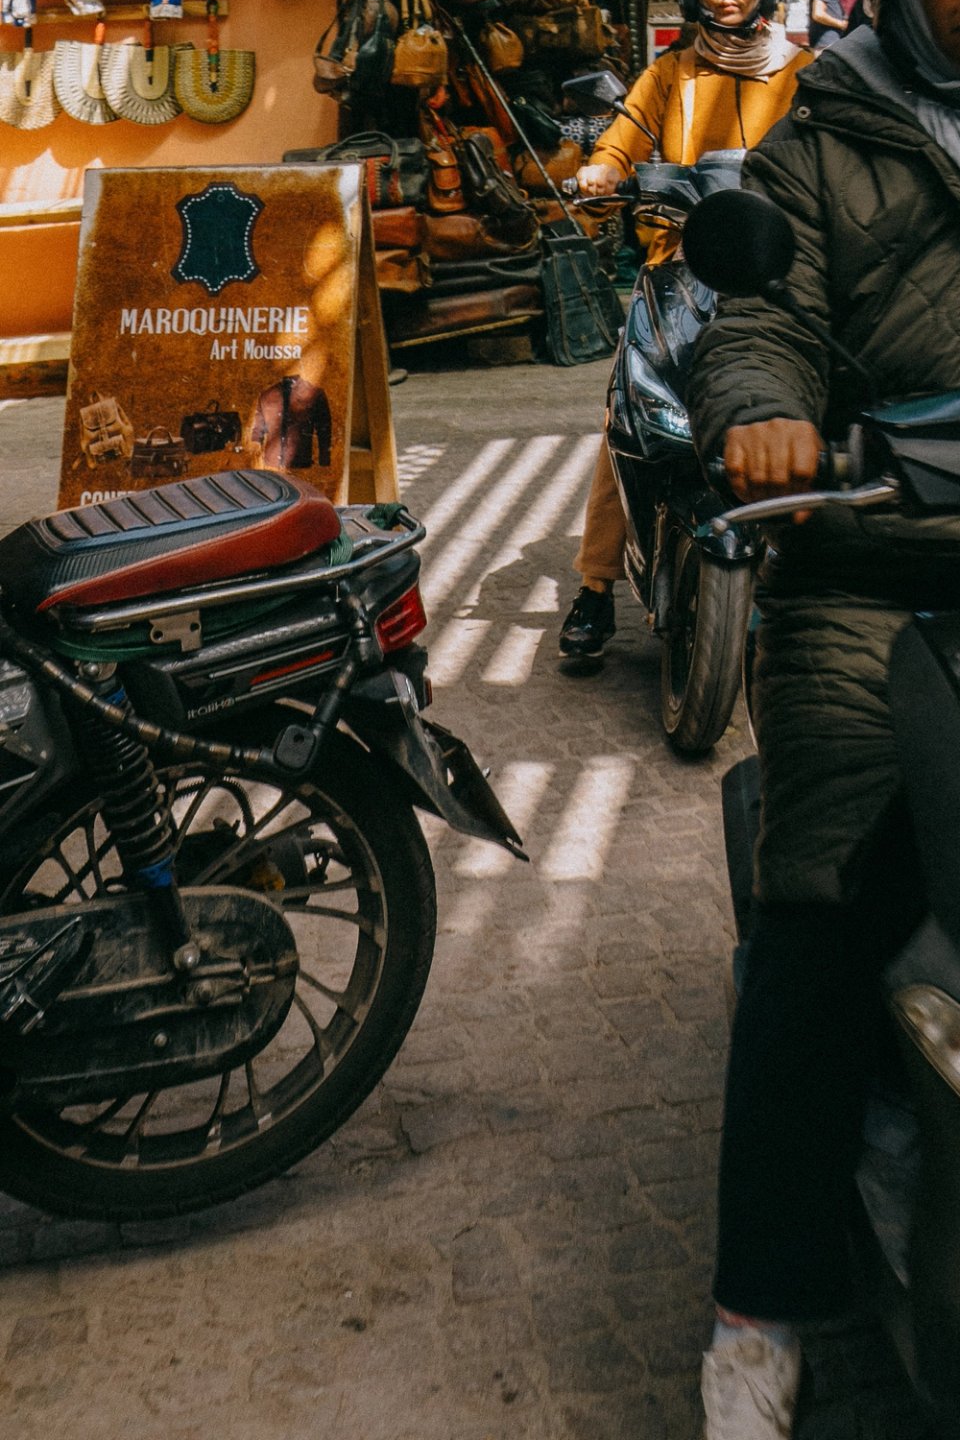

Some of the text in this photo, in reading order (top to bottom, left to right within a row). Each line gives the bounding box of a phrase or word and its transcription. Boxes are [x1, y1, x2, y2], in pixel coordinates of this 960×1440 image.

[120, 306, 309, 335] MAROQUINERIE
[210, 337, 302, 360] Art Moussa
